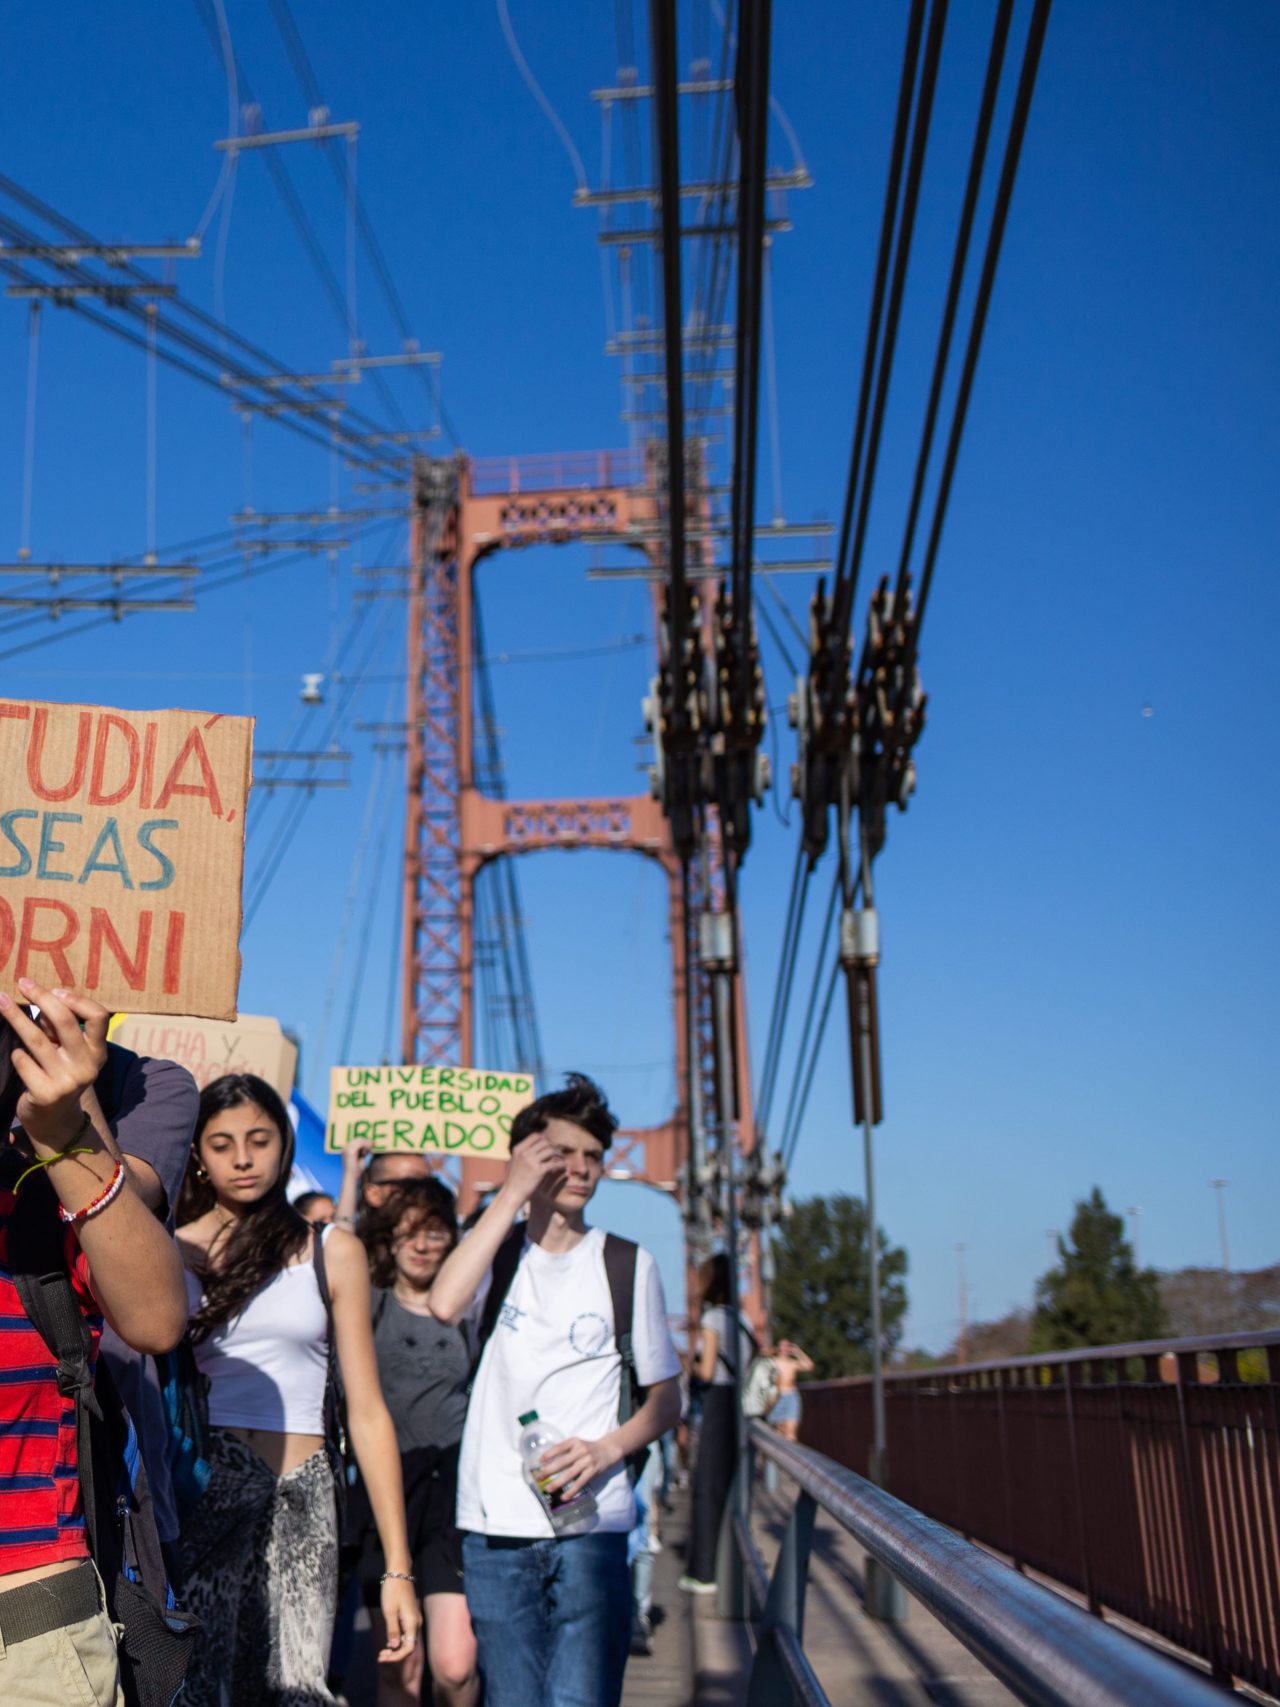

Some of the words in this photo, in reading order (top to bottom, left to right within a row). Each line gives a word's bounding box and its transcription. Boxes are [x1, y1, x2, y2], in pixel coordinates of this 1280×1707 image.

[222, 1034, 242, 1063] Y
[347, 1066, 531, 1094] UNIVERSIDAD
[336, 1091, 375, 1108] DEL
[390, 1089, 501, 1115] PUEBLO
